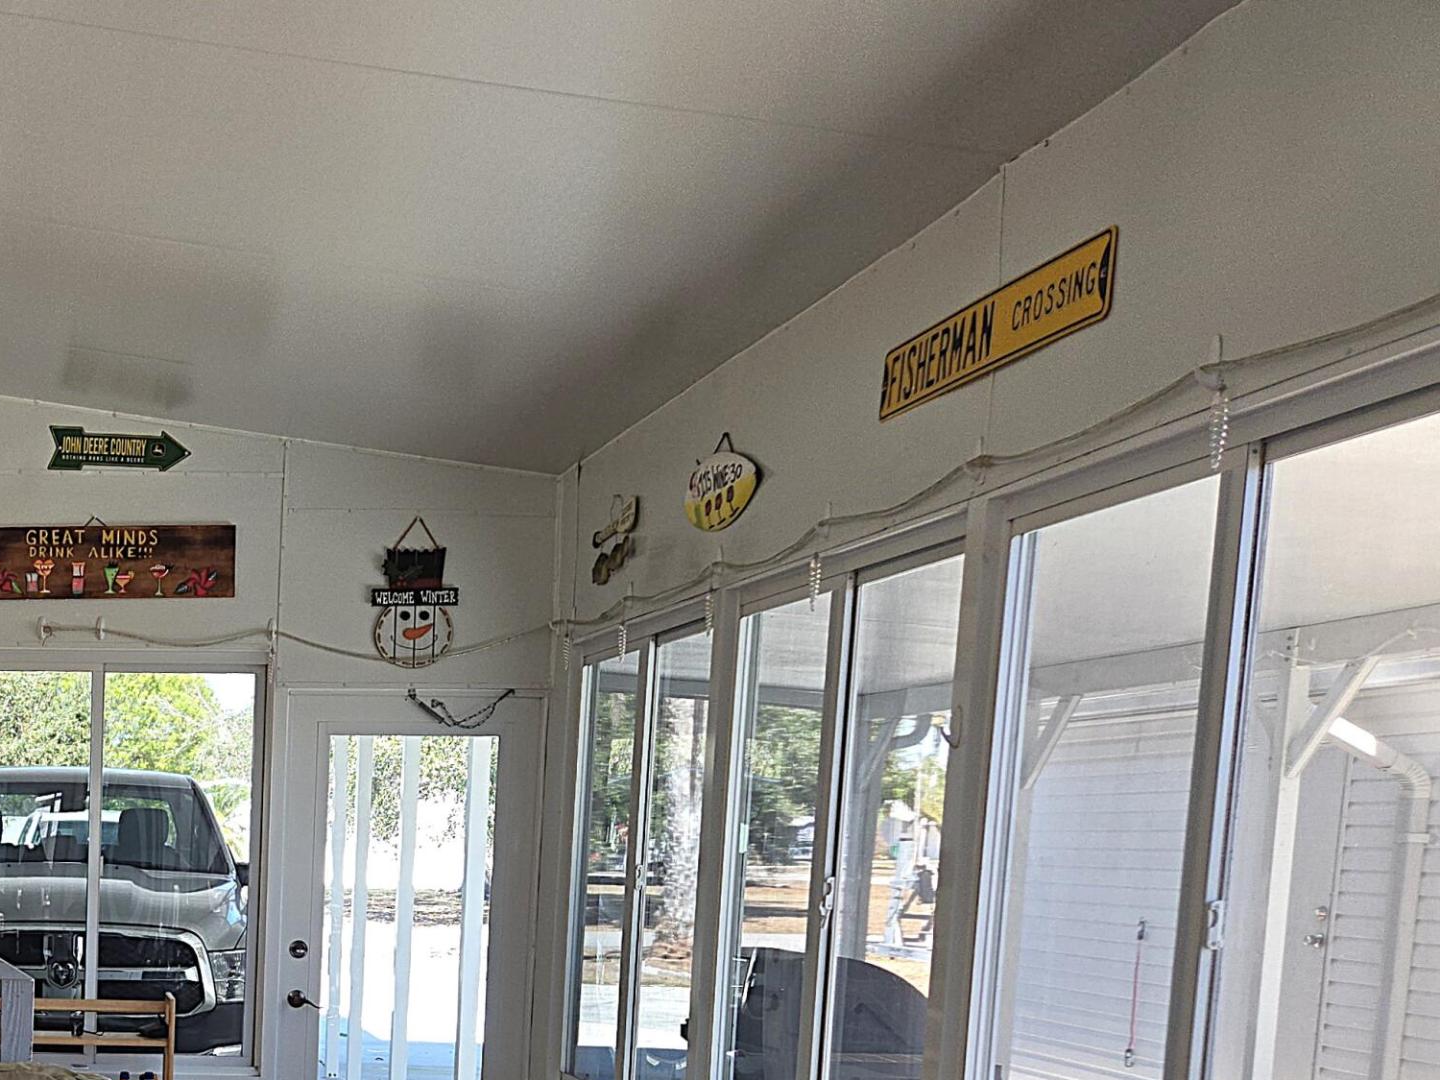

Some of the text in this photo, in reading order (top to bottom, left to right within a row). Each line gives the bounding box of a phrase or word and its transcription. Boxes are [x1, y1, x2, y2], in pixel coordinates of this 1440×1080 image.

[886, 262, 1097, 408] FISHERMAN CROSSING
[61, 436, 147, 456] JOHN DEERE COUNTRY
[26, 529, 159, 546] GREAT MINDS
[29, 547, 153, 559] DRINK ALIKE!!!
[375, 589, 456, 605] WELCOME WINTER
